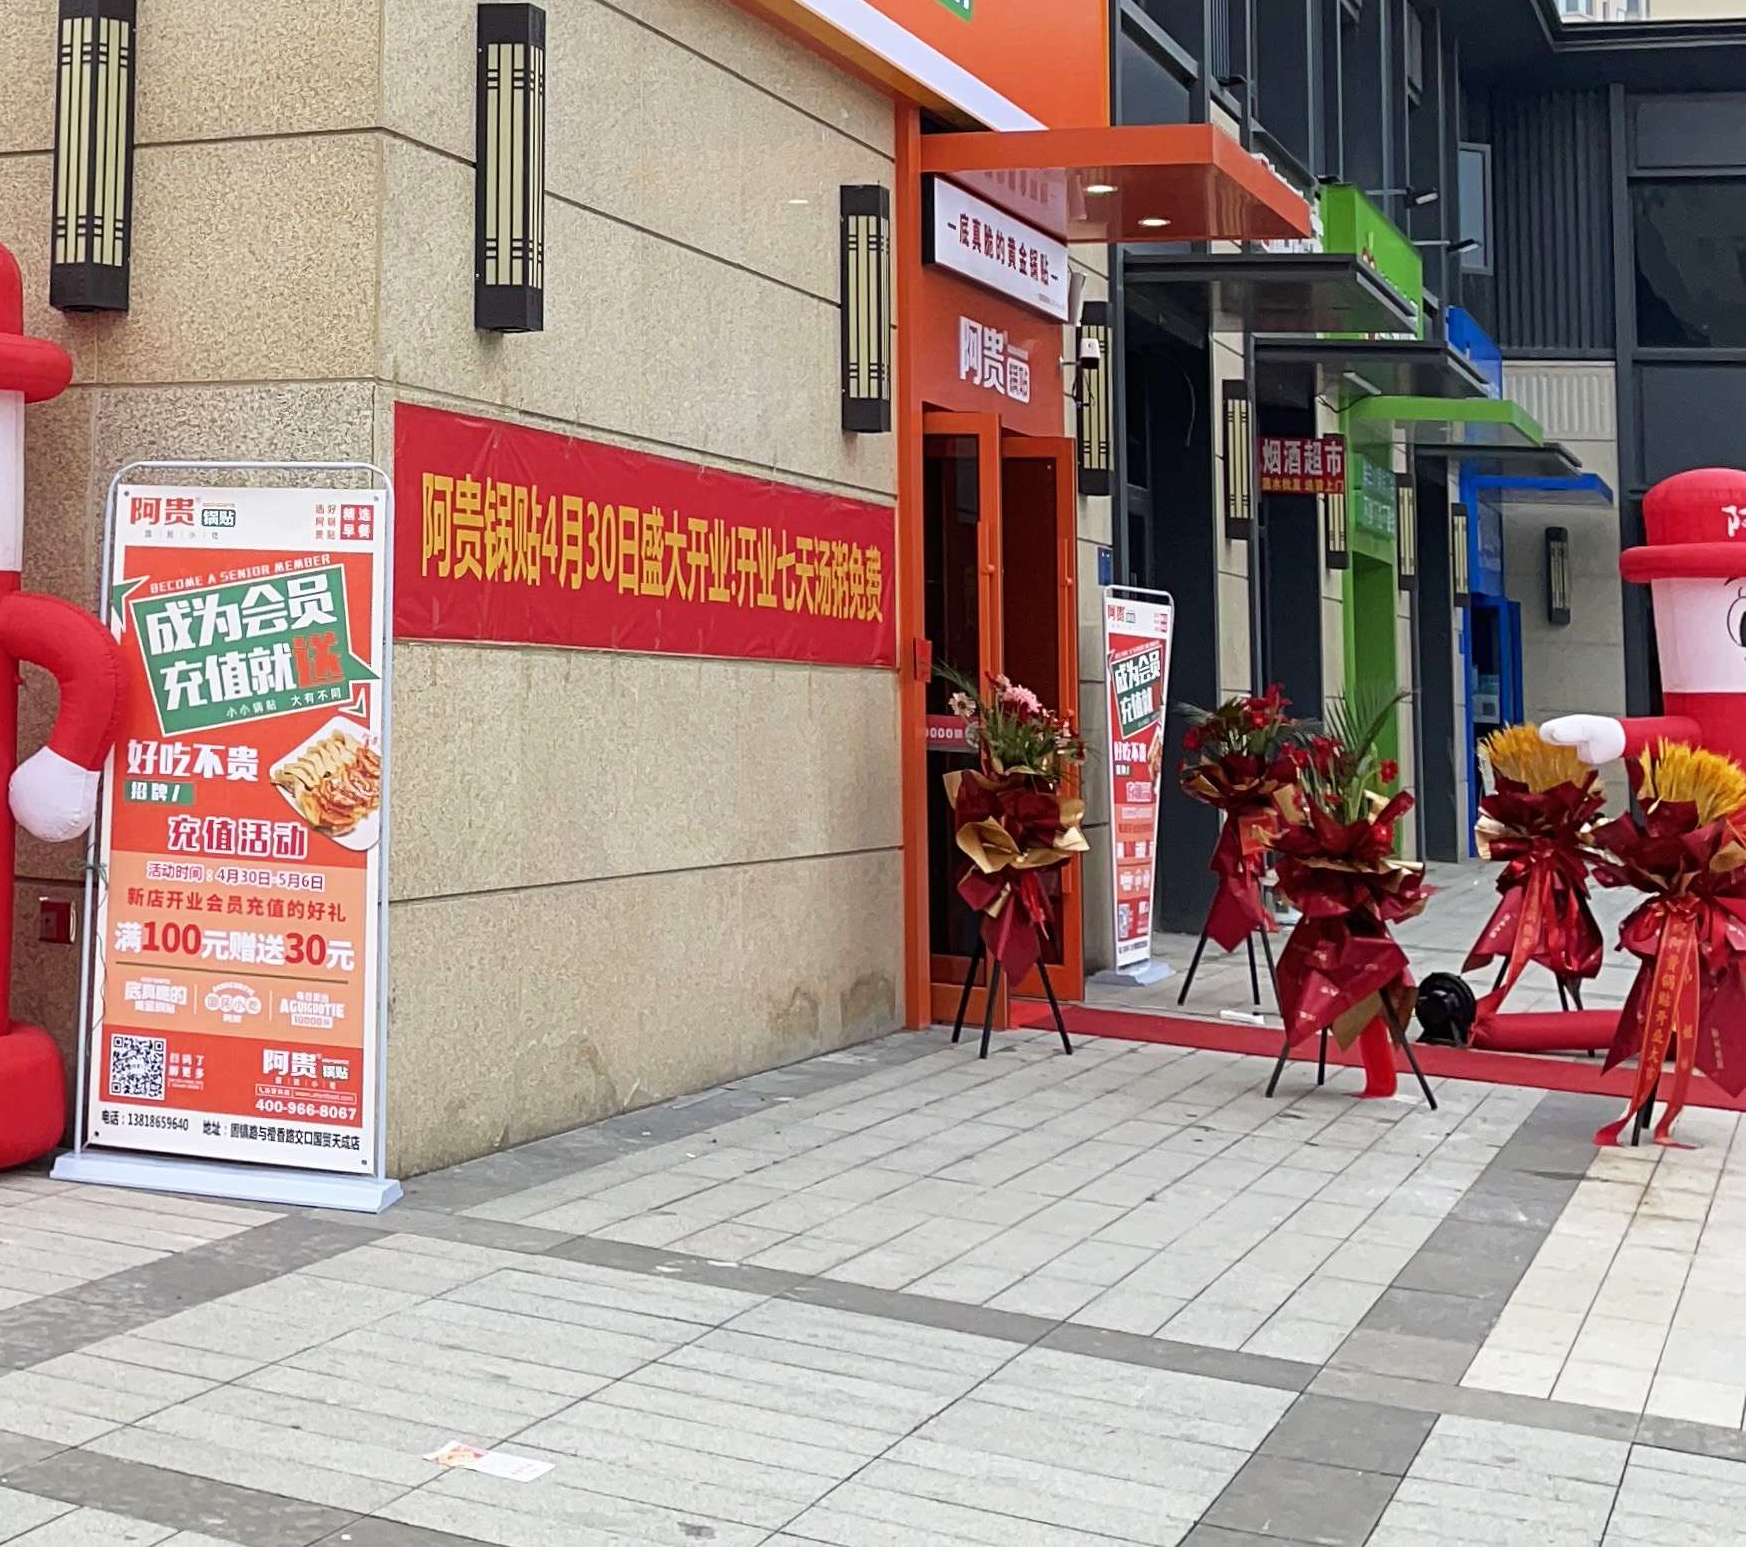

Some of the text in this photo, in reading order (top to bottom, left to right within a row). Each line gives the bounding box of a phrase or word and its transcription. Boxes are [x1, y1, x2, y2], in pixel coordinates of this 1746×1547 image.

[1262, 438, 1343, 477] 烟酒超市
[130, 497, 235, 527] 阿贵 锅贴
[150, 553, 332, 595] BECOME A SENIOR MEMBER
[145, 573, 338, 655] 成为会员
[160, 630, 346, 711] 充值就送
[290, 686, 342, 707] 大有不同
[127, 738, 259, 782] 好吃不贵
[167, 815, 307, 858] 充值活动
[127, 887, 347, 923] 新店开业会员充值的好礼
[113, 921, 356, 972] 满100元赠送30元
[263, 1048, 317, 1079] 阿贵
[255, 1098, 358, 1121] 400-966-8067
